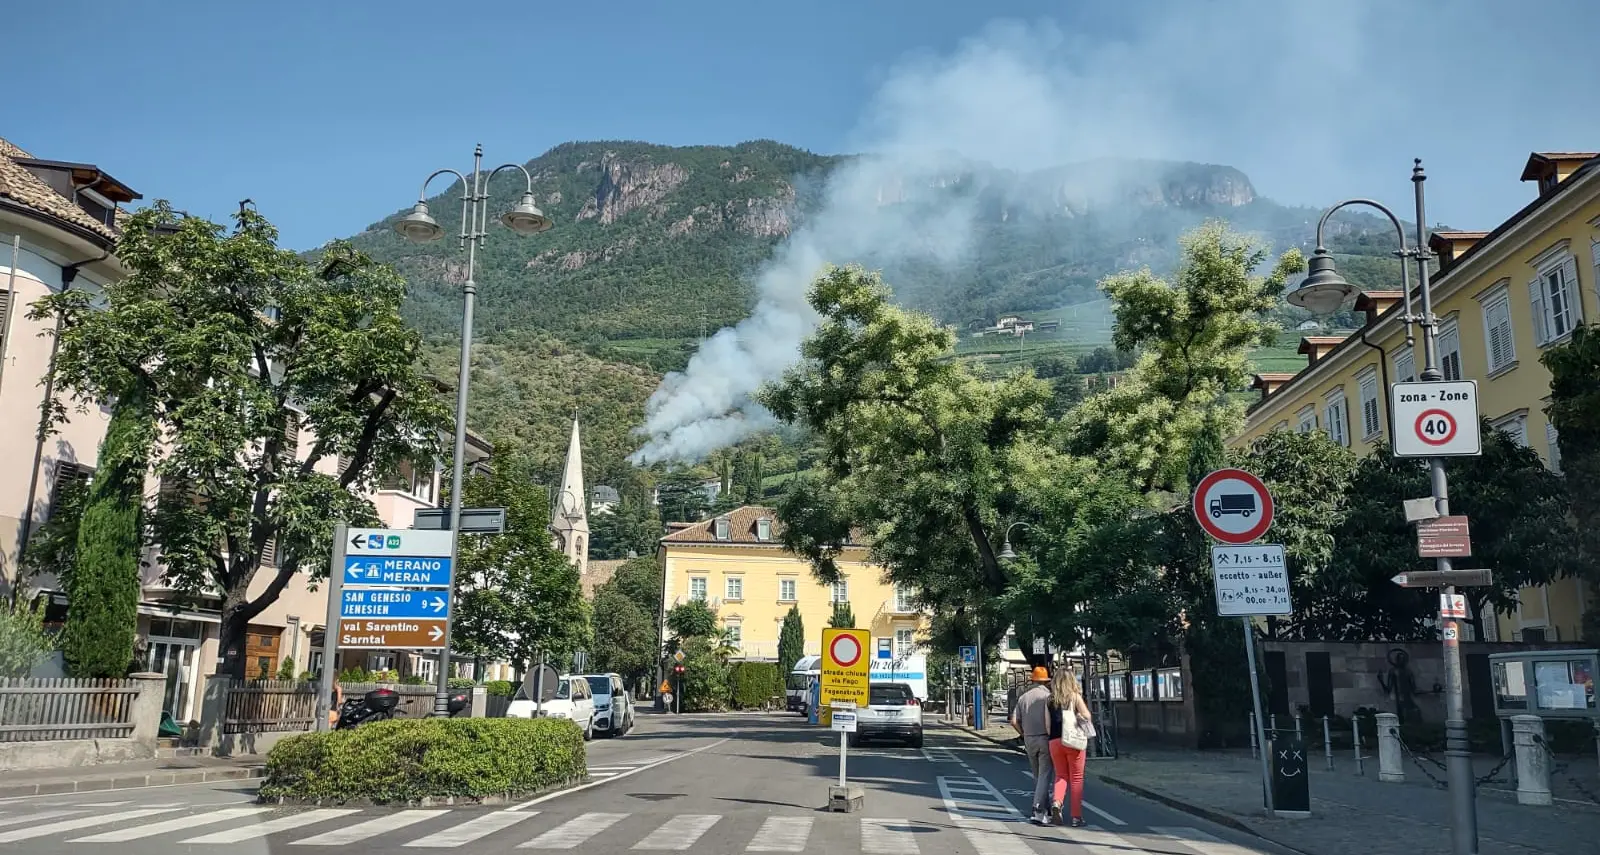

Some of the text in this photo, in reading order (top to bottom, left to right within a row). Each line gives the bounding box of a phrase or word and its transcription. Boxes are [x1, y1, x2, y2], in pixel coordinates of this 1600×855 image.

[1400, 394, 1427, 402] zona
[1439, 390, 1469, 401] Zone
[1425, 420, 1447, 435] 40
[384, 560, 441, 571] MERANO
[383, 572, 431, 583] MERAN
[1258, 570, 1282, 579] außer
[345, 592, 411, 603] SAN GENESIO
[421, 599, 428, 609] 9
[344, 605, 389, 615] JENESIEN
[343, 621, 419, 632] val Sarentino
[342, 635, 386, 645] Sarntal
[963, 648, 972, 660] P
[824, 688, 864, 696] Fagenstraße
